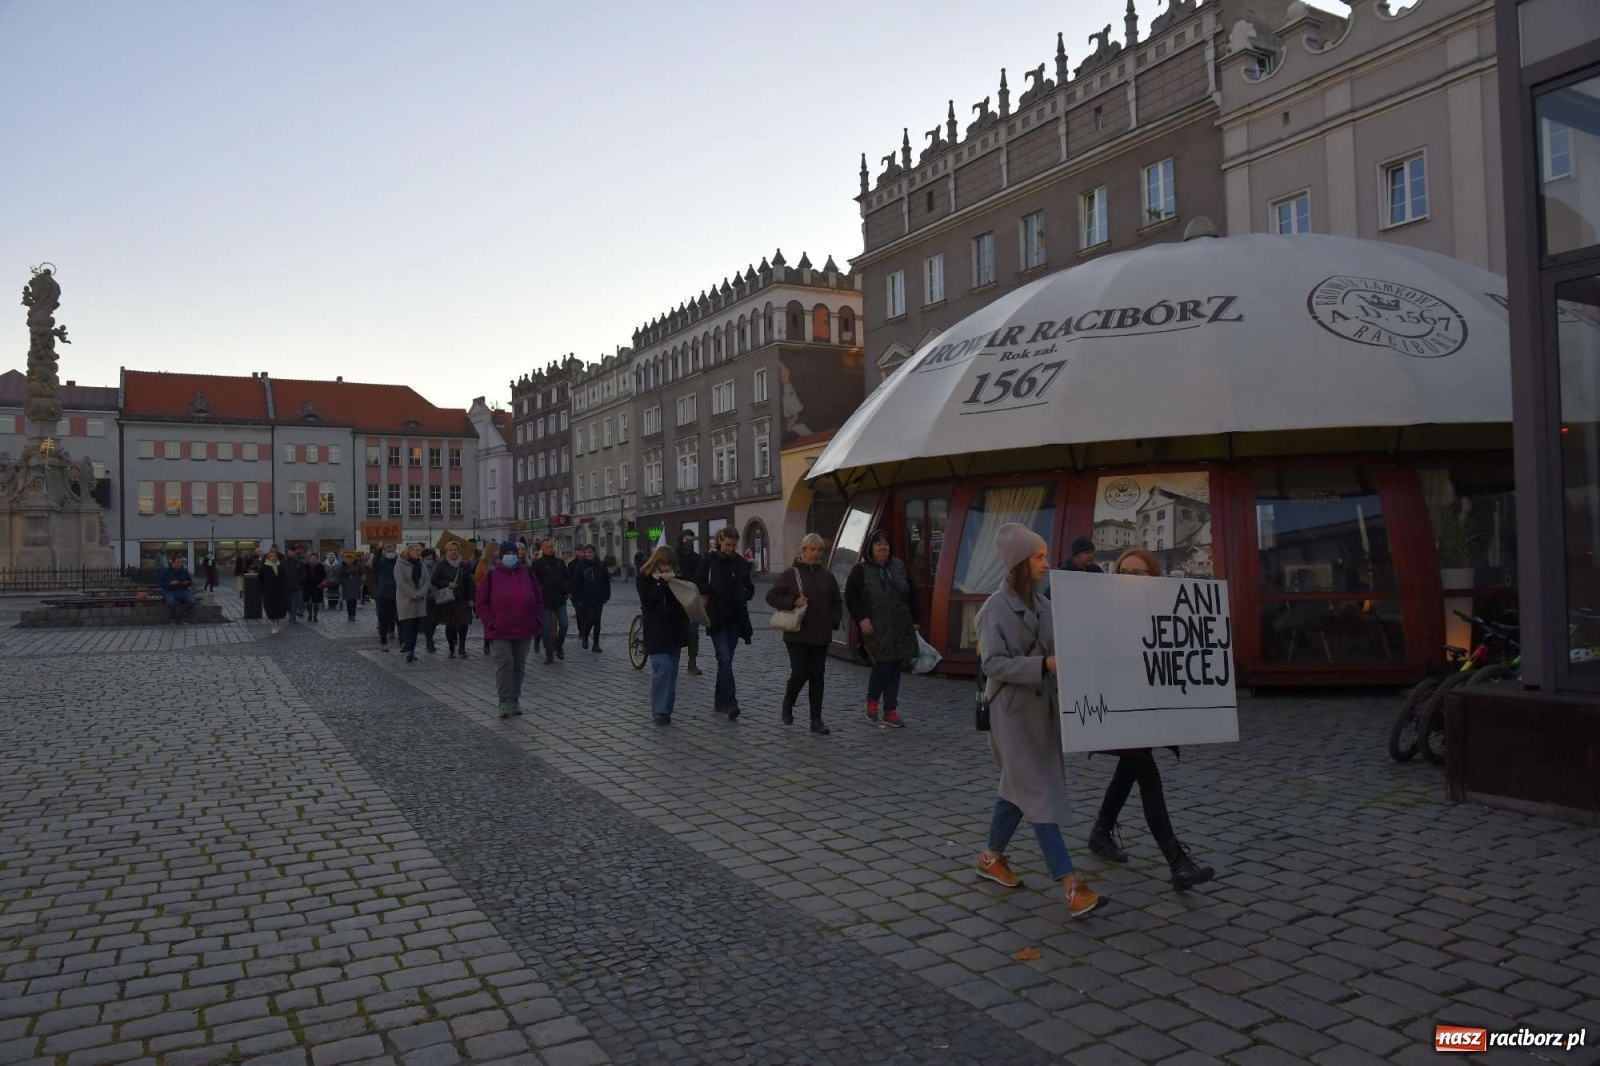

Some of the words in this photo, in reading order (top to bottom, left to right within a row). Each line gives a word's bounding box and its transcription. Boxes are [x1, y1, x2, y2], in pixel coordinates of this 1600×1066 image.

[1025, 295, 1244, 343] RACIBÓRZ
[1397, 309, 1451, 331] 1567
[999, 349, 1030, 361] Rok
[962, 359, 1068, 406] 1567
[366, 525, 399, 537] STOP
[1173, 583, 1221, 615] ANI
[1142, 616, 1230, 649] JEDNEJ
[1143, 650, 1229, 694] WIĘCEJ
